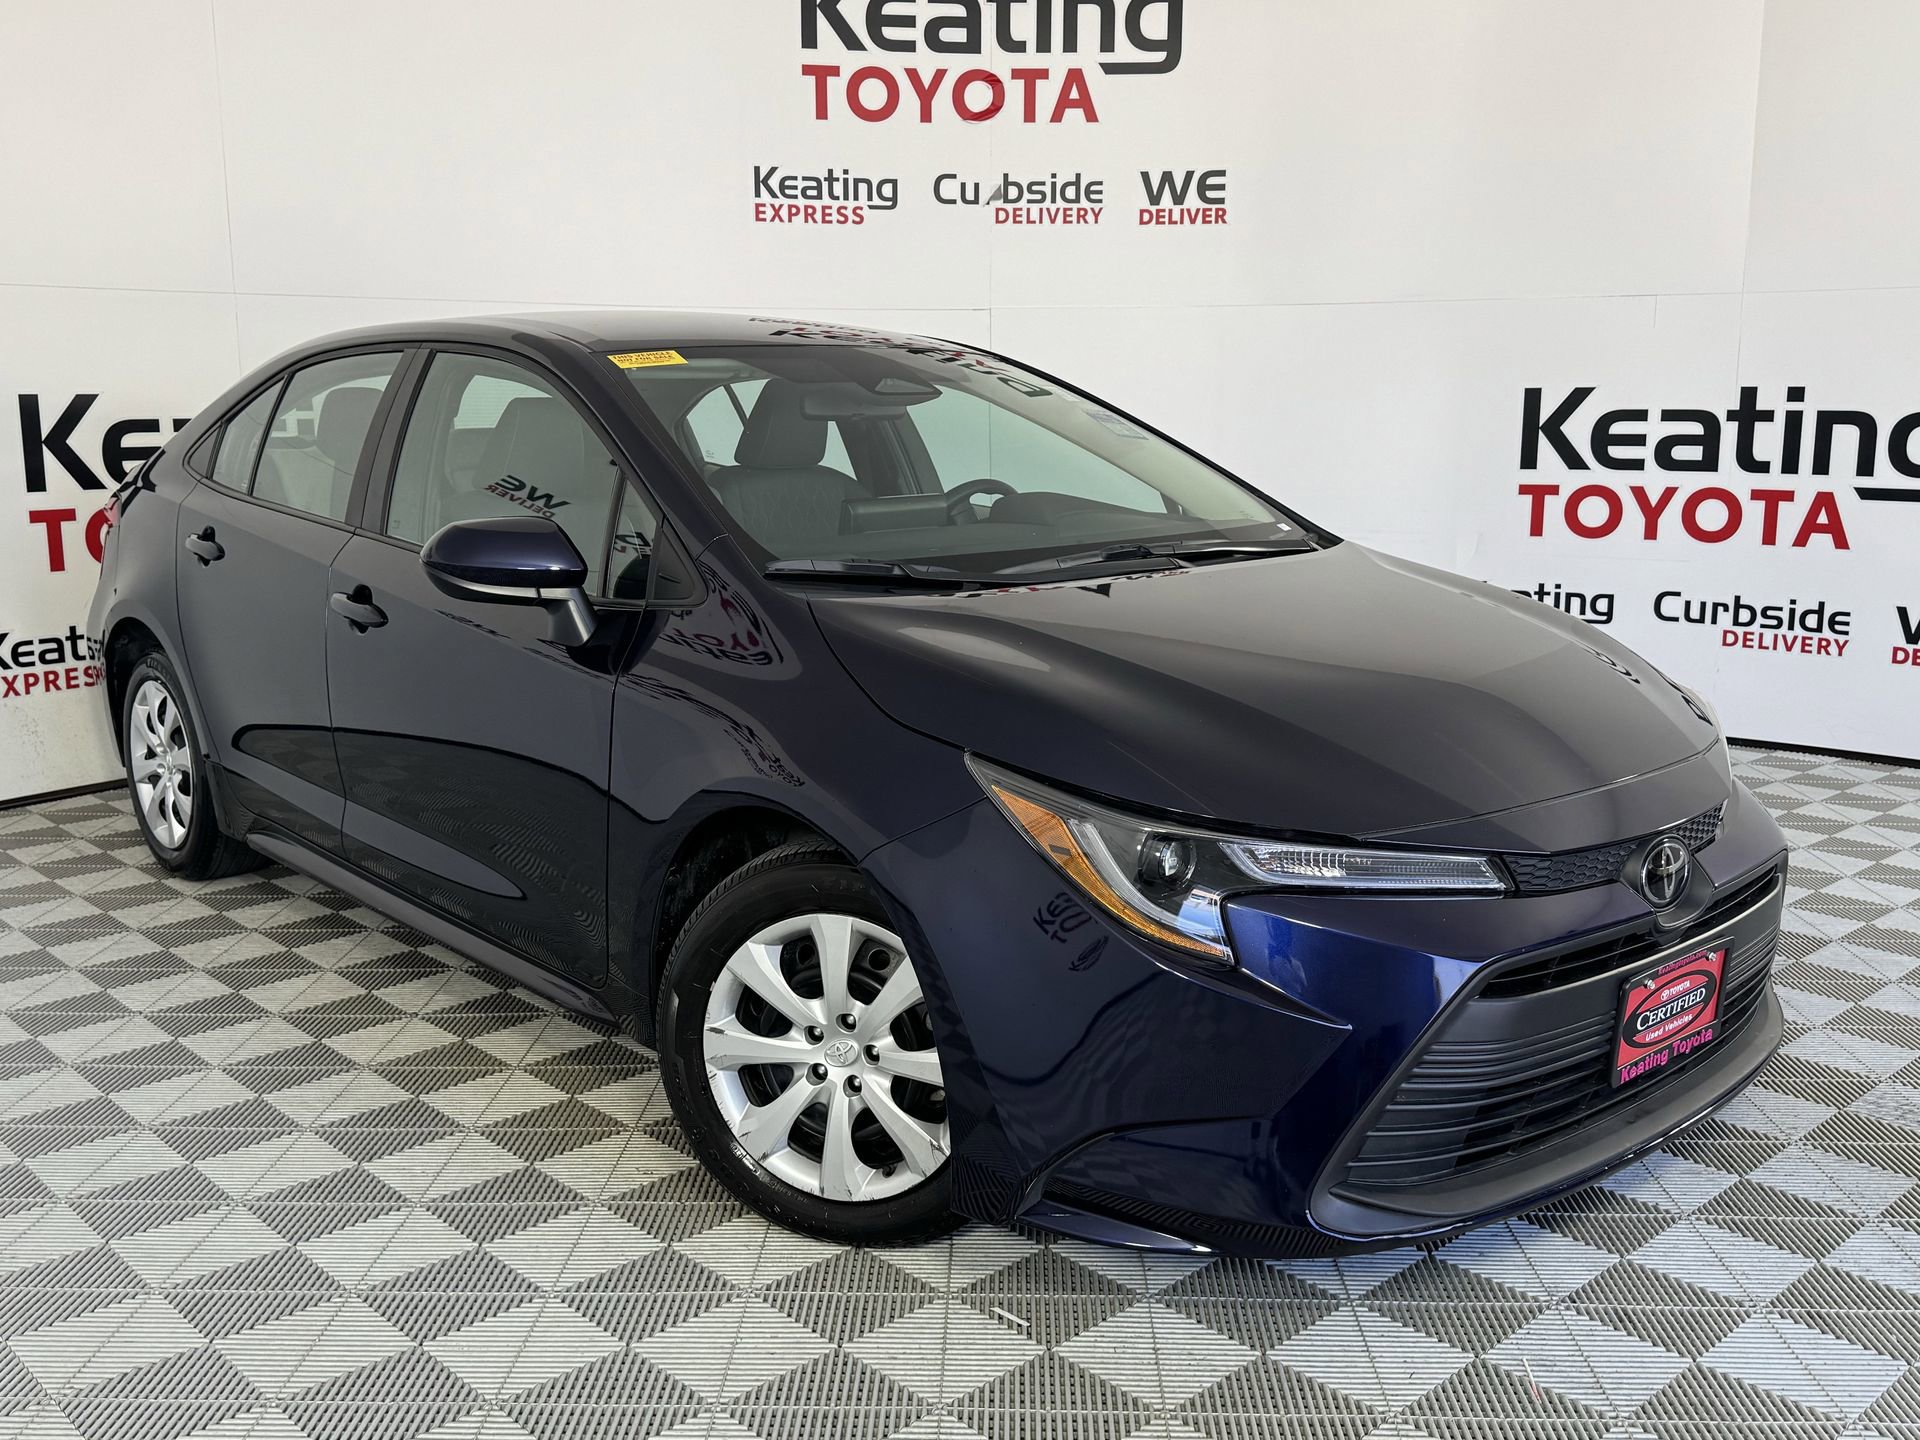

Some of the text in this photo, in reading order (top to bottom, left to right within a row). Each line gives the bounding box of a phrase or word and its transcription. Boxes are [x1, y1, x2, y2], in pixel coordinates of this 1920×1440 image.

[802, 64, 1099, 123] TOYOTA
[753, 166, 898, 210] Keating
[933, 173, 1103, 206] Cubside
[1140, 169, 1227, 206] WE
[754, 203, 865, 225] EXPRESS
[994, 207, 1103, 225] DELIVERY
[1138, 207, 1228, 225] DELIVER
[1518, 484, 1850, 550] TOYOTA
[1653, 589, 1851, 636] Curbside
[1722, 629, 1850, 657] DELIVERY
[1669, 980, 1691, 996] TOYOTA
[1636, 987, 1706, 1031] CERTIFIED
[1645, 1013, 1693, 1042] Used Vehicles
[1620, 1027, 1713, 1084] Keating Toyota
